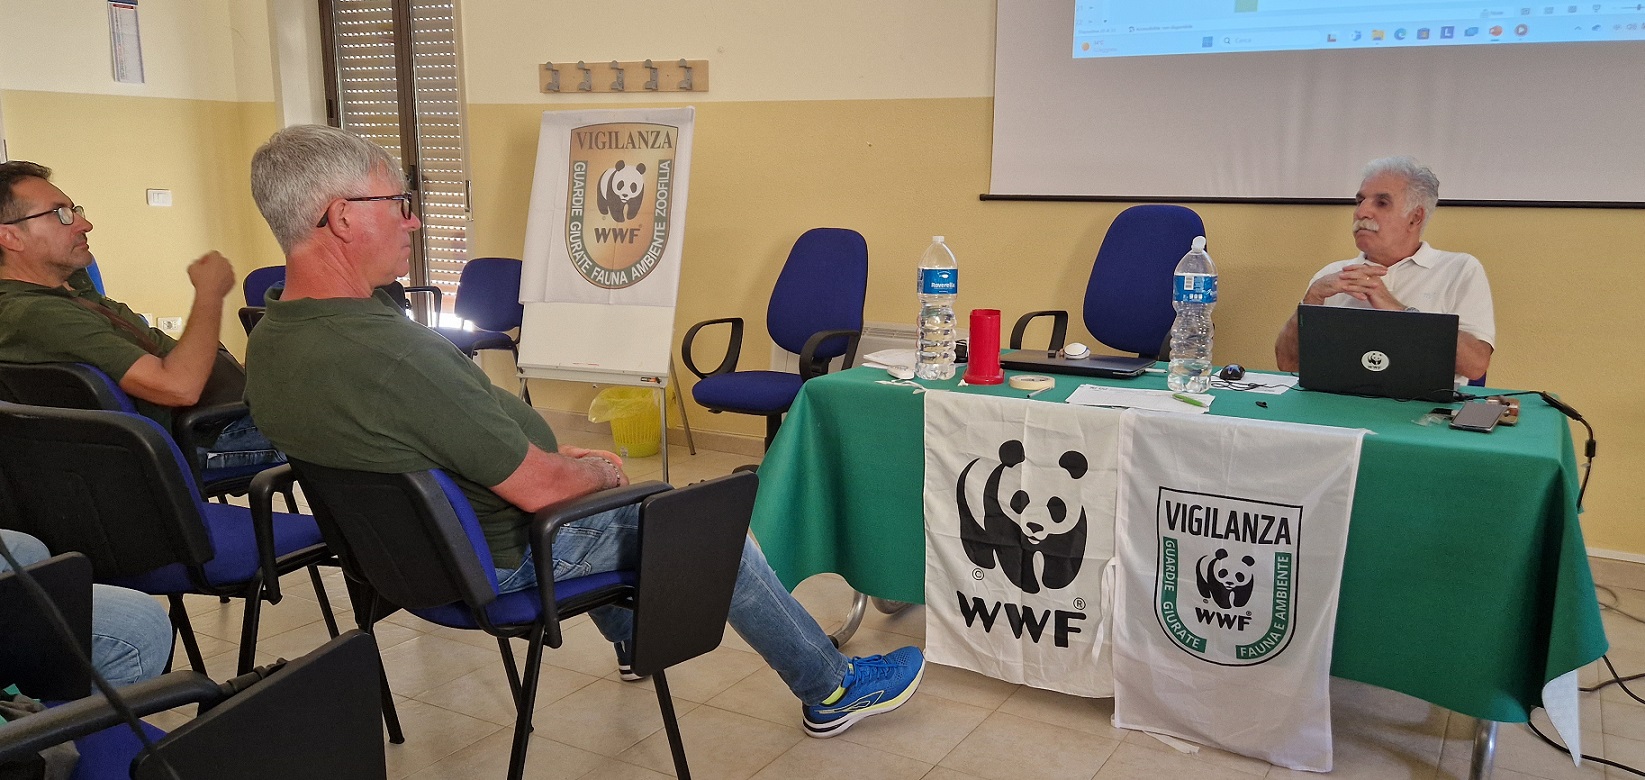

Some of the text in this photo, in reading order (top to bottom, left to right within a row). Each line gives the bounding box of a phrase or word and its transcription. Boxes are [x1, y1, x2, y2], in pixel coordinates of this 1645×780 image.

[576, 130, 673, 150] VIGILANZA
[569, 160, 671, 286] GUARDIE GIURATE FAUNA AMBIENTE ZOOFILIA
[594, 227, 641, 244] WWF
[1165, 500, 1291, 545] VIGILANZA
[956, 589, 1088, 648] WWF
[1162, 540, 1201, 649] GUARDIE GIURATE
[1194, 606, 1252, 631] WWF
[1239, 556, 1289, 659] FAUNA E AMBIENTE
